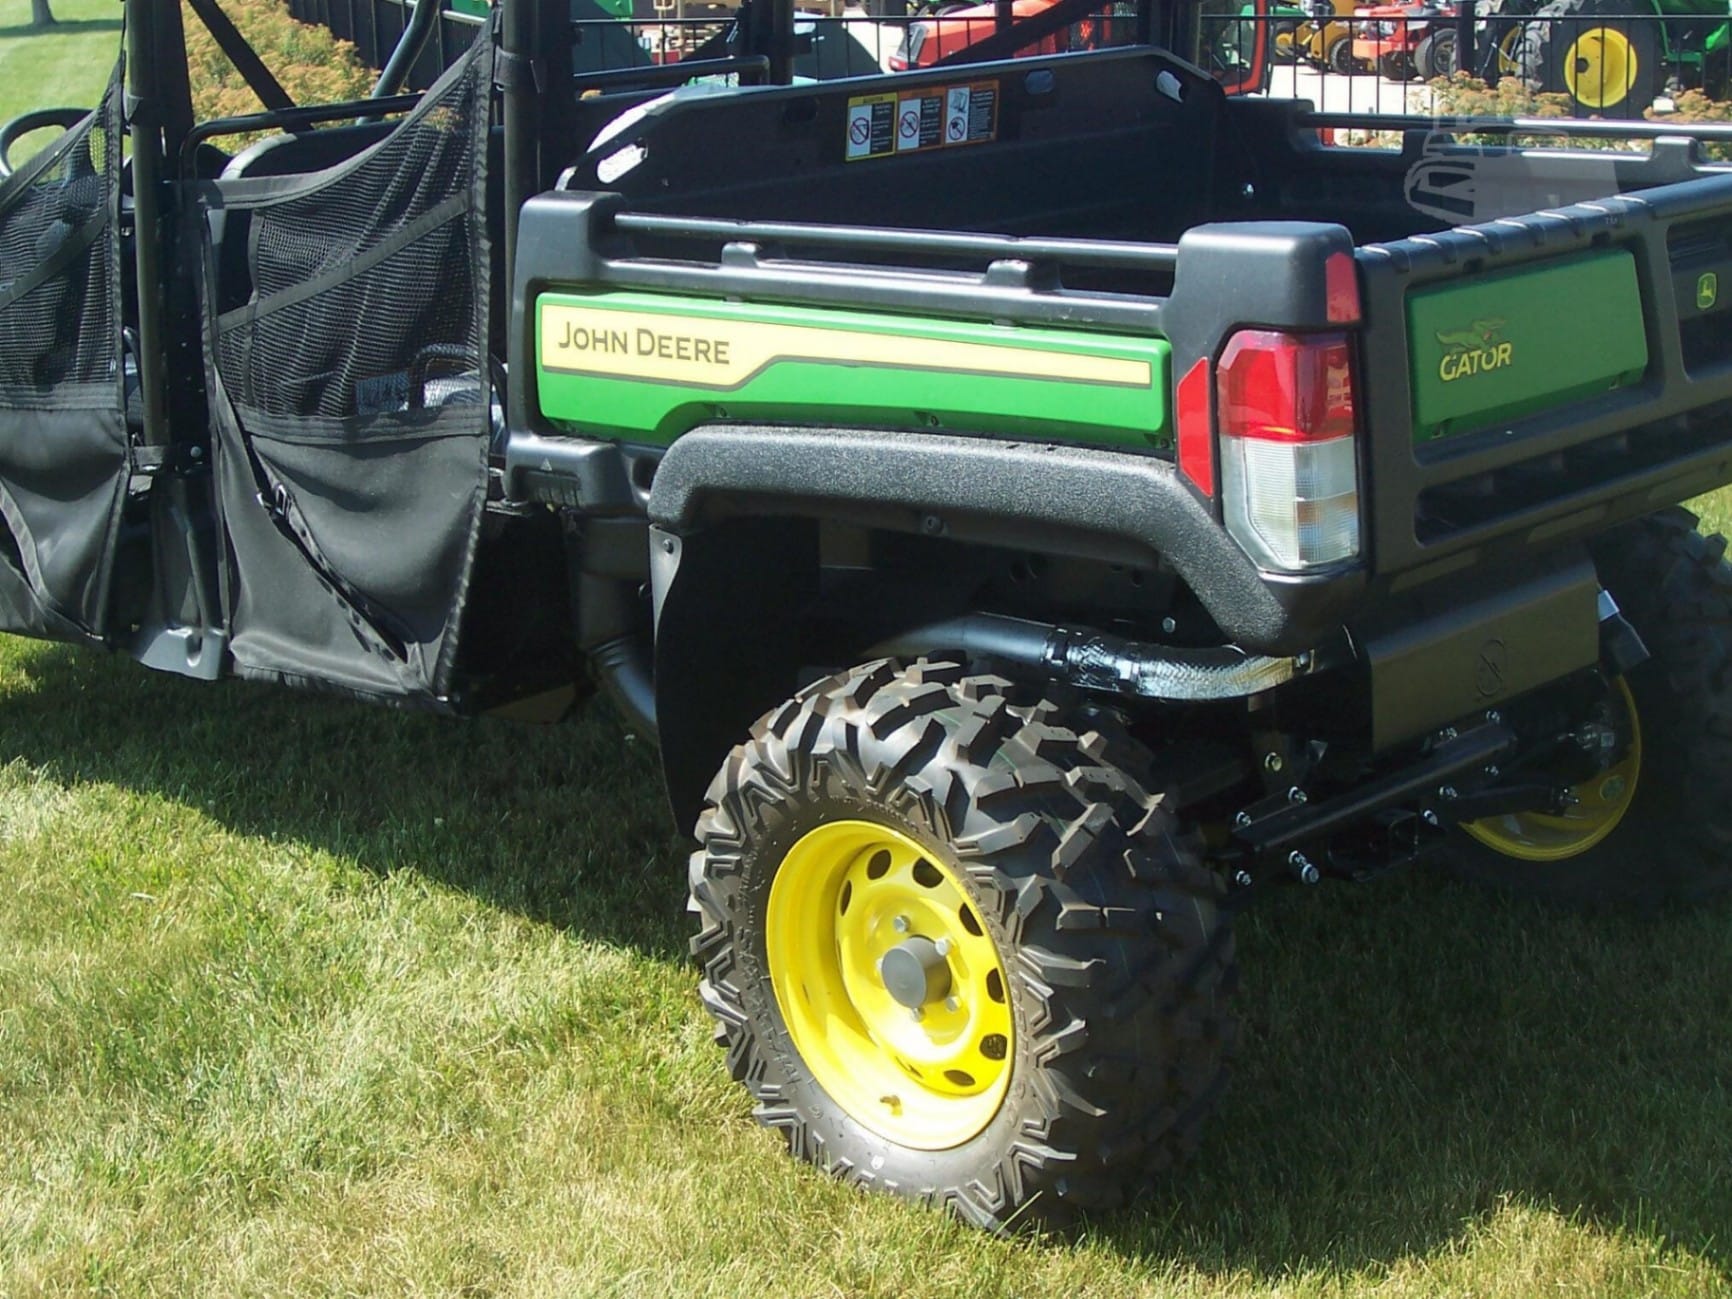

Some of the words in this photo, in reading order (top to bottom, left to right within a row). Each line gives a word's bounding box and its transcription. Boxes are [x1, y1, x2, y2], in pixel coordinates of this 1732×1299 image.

[558, 321, 628, 354] JOHN
[636, 328, 730, 365] DEERE
[1439, 341, 1512, 381] GATOR
